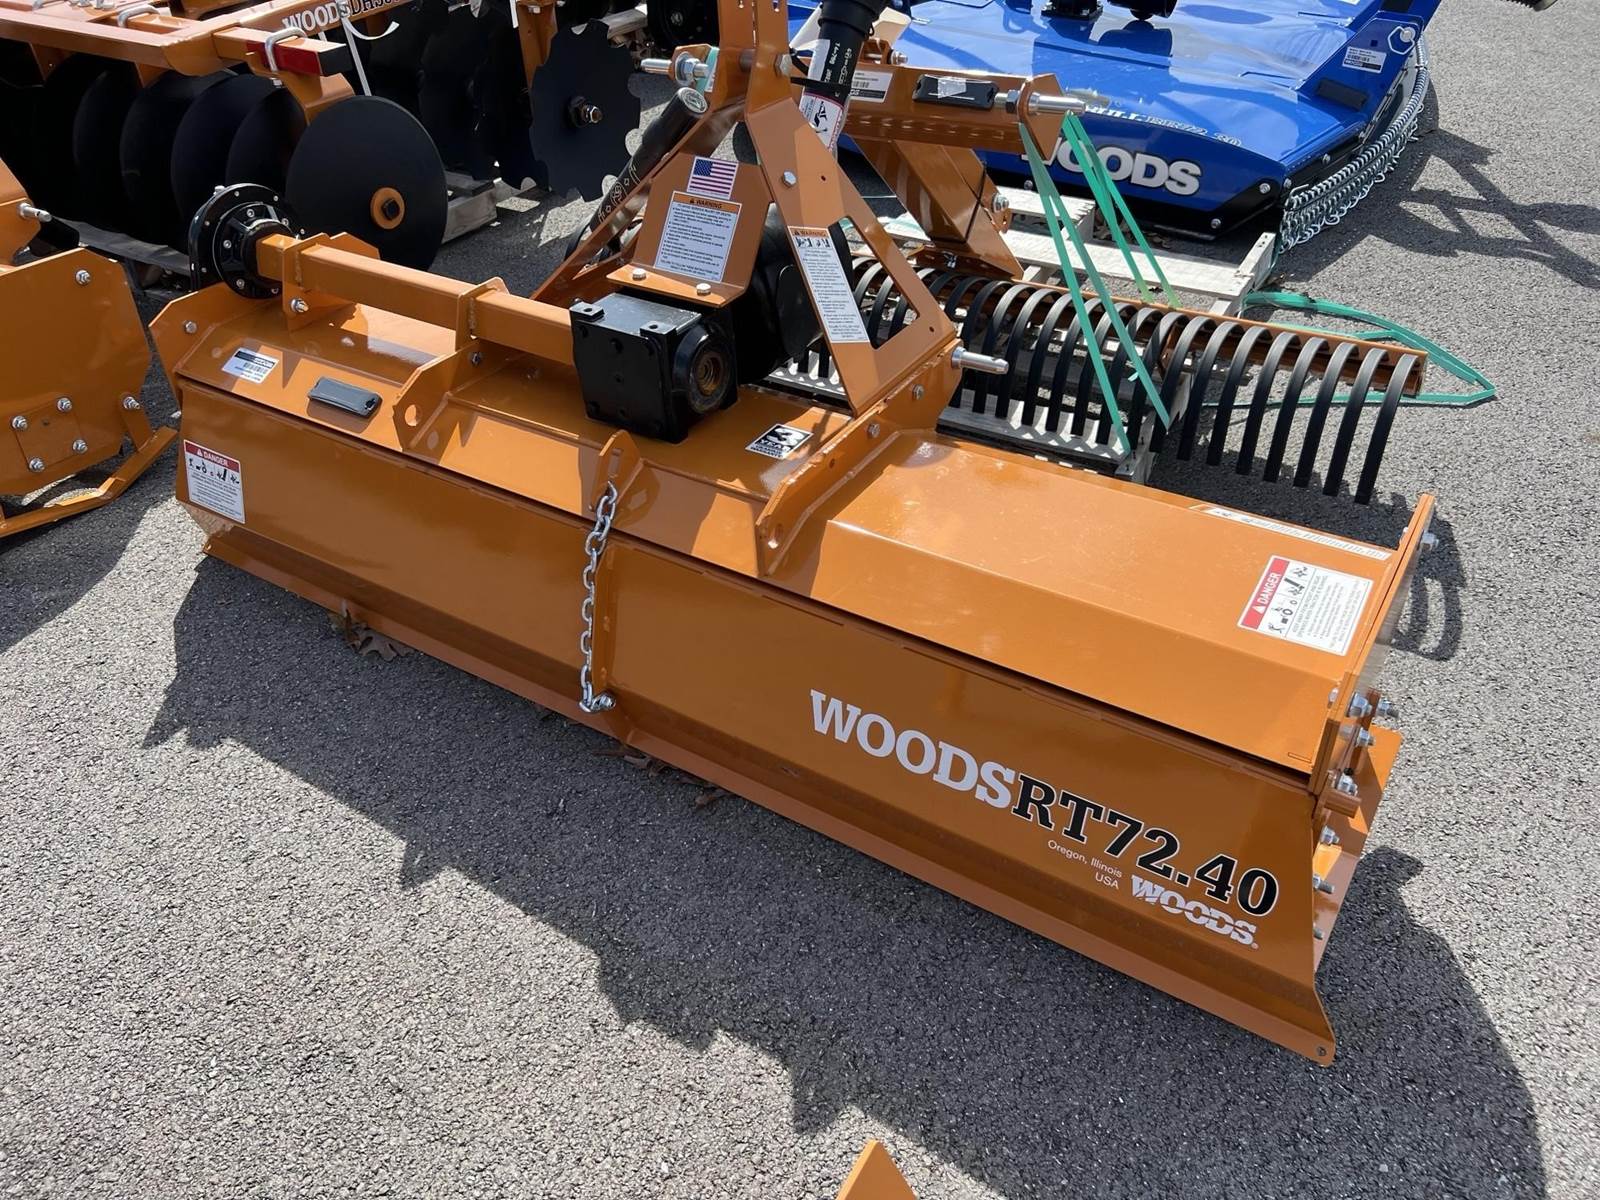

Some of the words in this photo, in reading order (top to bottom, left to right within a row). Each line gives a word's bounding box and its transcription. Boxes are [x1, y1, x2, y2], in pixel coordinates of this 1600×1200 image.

[767, 427, 806, 446] 3
[203, 451, 229, 466] DANGER
[1256, 572, 1283, 606] DANGER
[1047, 839, 1087, 864] Oregon,
[1090, 857, 1122, 878] Illinois
[1095, 871, 1119, 889] USA
